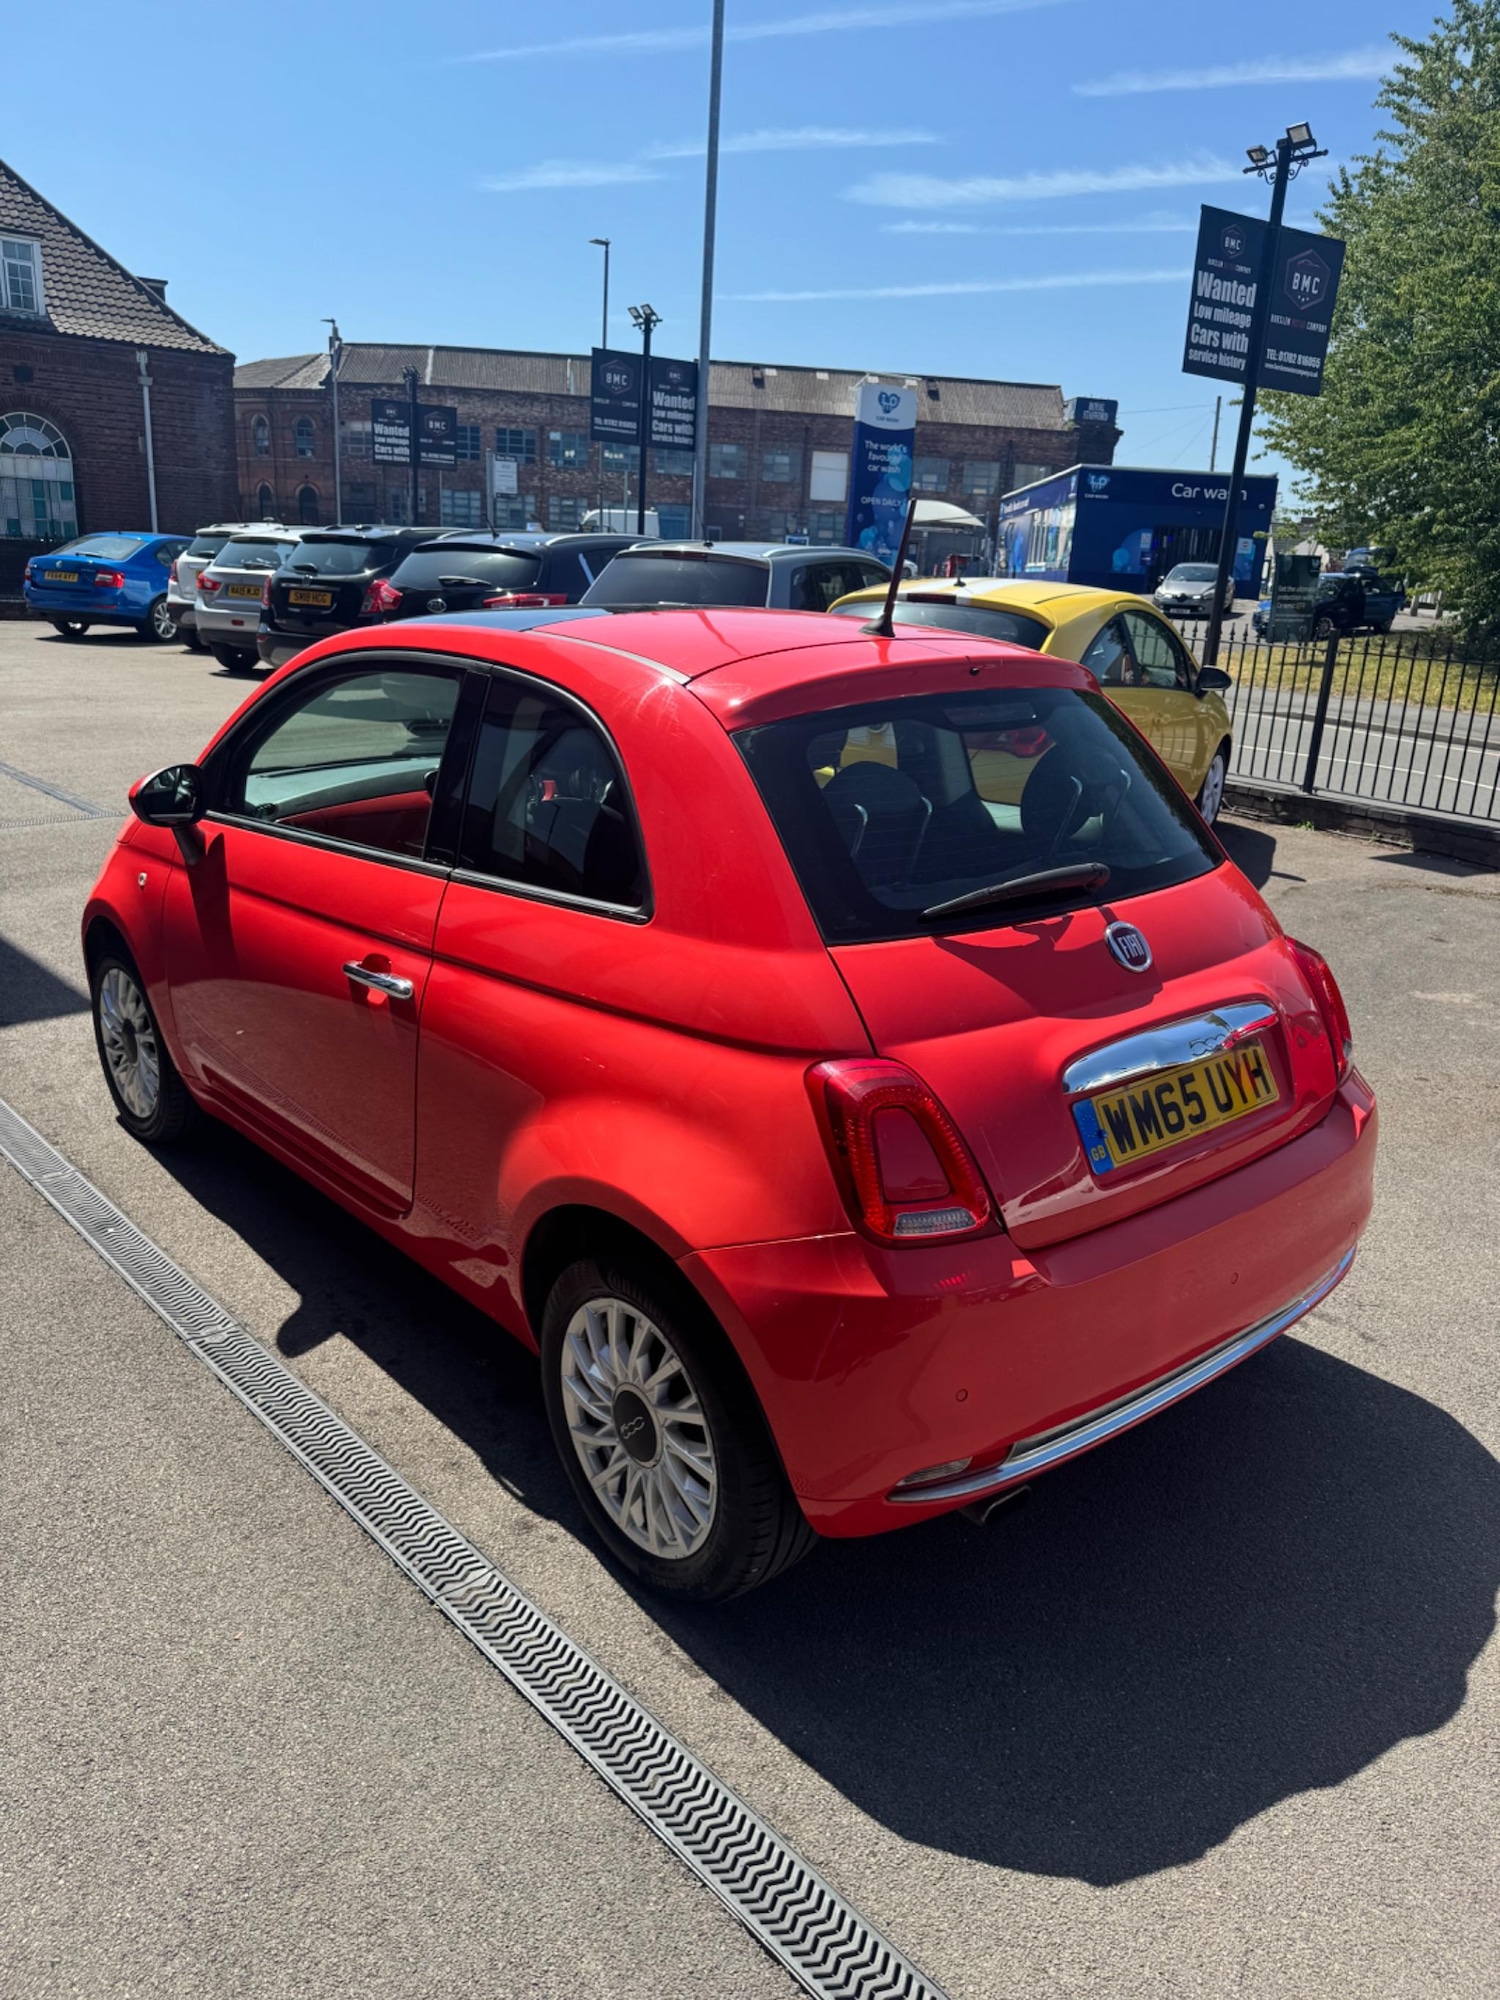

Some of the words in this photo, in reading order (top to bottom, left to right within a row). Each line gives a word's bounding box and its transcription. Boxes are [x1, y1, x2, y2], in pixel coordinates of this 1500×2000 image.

[1224, 236, 1242, 250] BMC
[1197, 270, 1257, 308] Wanted
[1292, 272, 1320, 294] BMC
[1194, 301, 1212, 319] Low
[1214, 306, 1252, 328] mileage
[1190, 323, 1220, 347] Cars
[1221, 330, 1248, 353] with
[1188, 348, 1218, 365] service
[1218, 352, 1246, 372] history
[606, 372, 627, 386] BMC
[653, 391, 695, 410] Wanted
[652, 408, 665, 417] Low
[667, 410, 694, 422] mileage
[374, 422, 409, 437] Wanted
[429, 420, 446, 430] BMC
[652, 420, 673, 433] Cars
[674, 424, 694, 436] with
[652, 434, 673, 442] service
[374, 444, 392, 454] Cars
[865, 440, 879, 450] The
[880, 443, 907, 453] world's
[867, 464, 879, 472] car
[881, 464, 900, 473] wash
[1172, 483, 1200, 498] Car
[1204, 488, 1248, 501] wa
[861, 496, 881, 505] OPEN
[882, 497, 902, 506] DAILY
[1118, 933, 1144, 960] FIAT
[1102, 1073, 1206, 1154] WM65
[1204, 1049, 1272, 1114] UYH
[1090, 1144, 1106, 1162] GB
